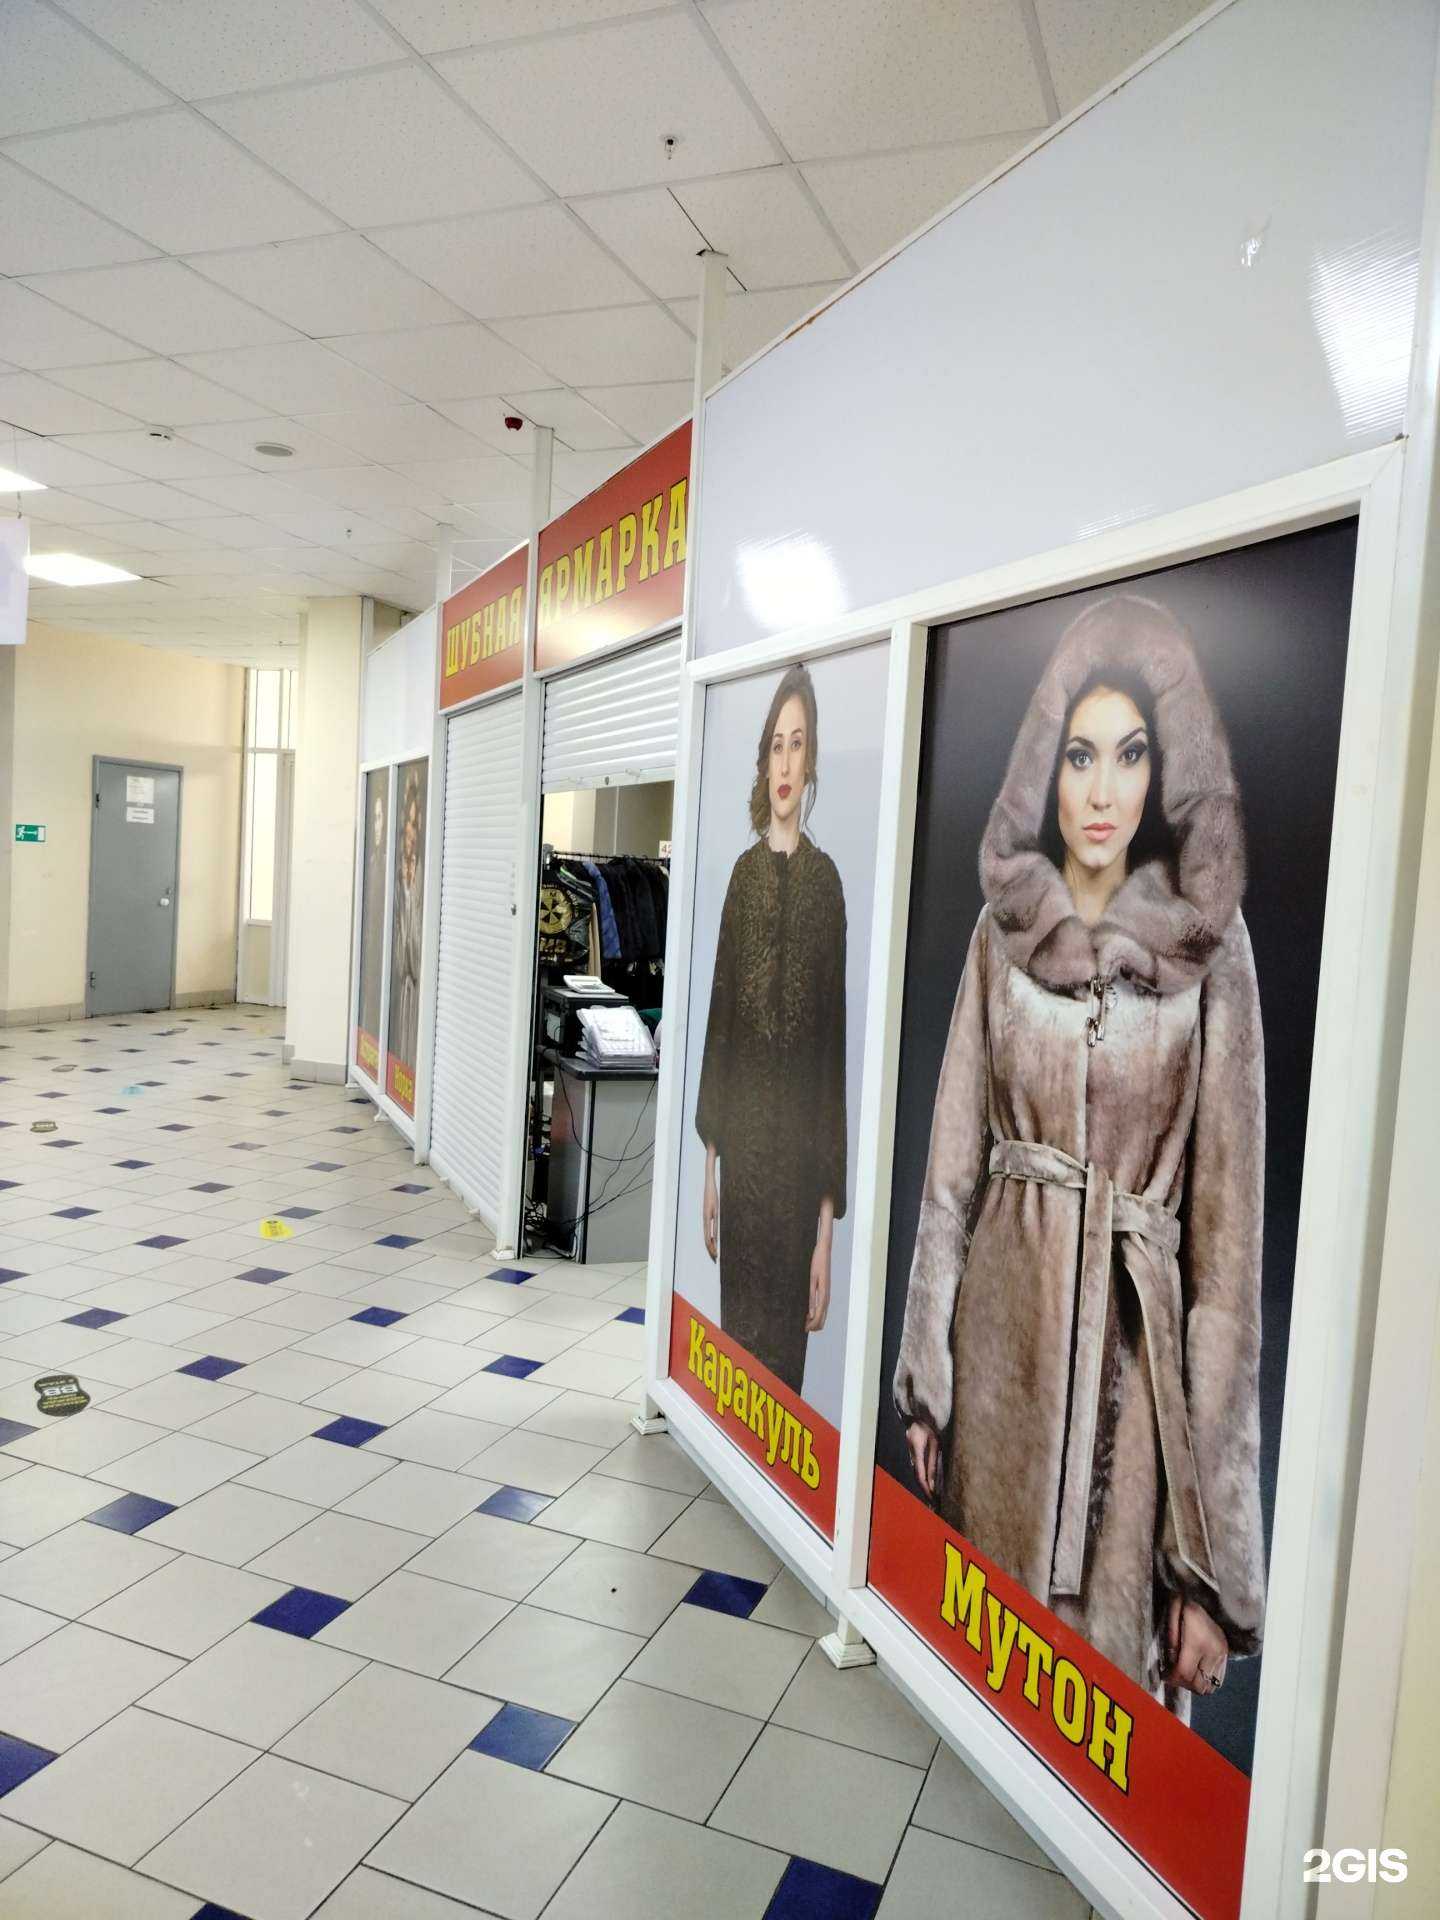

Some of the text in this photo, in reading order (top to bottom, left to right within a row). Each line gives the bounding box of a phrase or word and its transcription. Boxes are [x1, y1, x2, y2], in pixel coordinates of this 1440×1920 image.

[445, 476, 688, 678] ШУБНАЯ ЯРМАРКА
[687, 1315, 821, 1491] Каракуль
[939, 1538, 1134, 1797] Мутон
